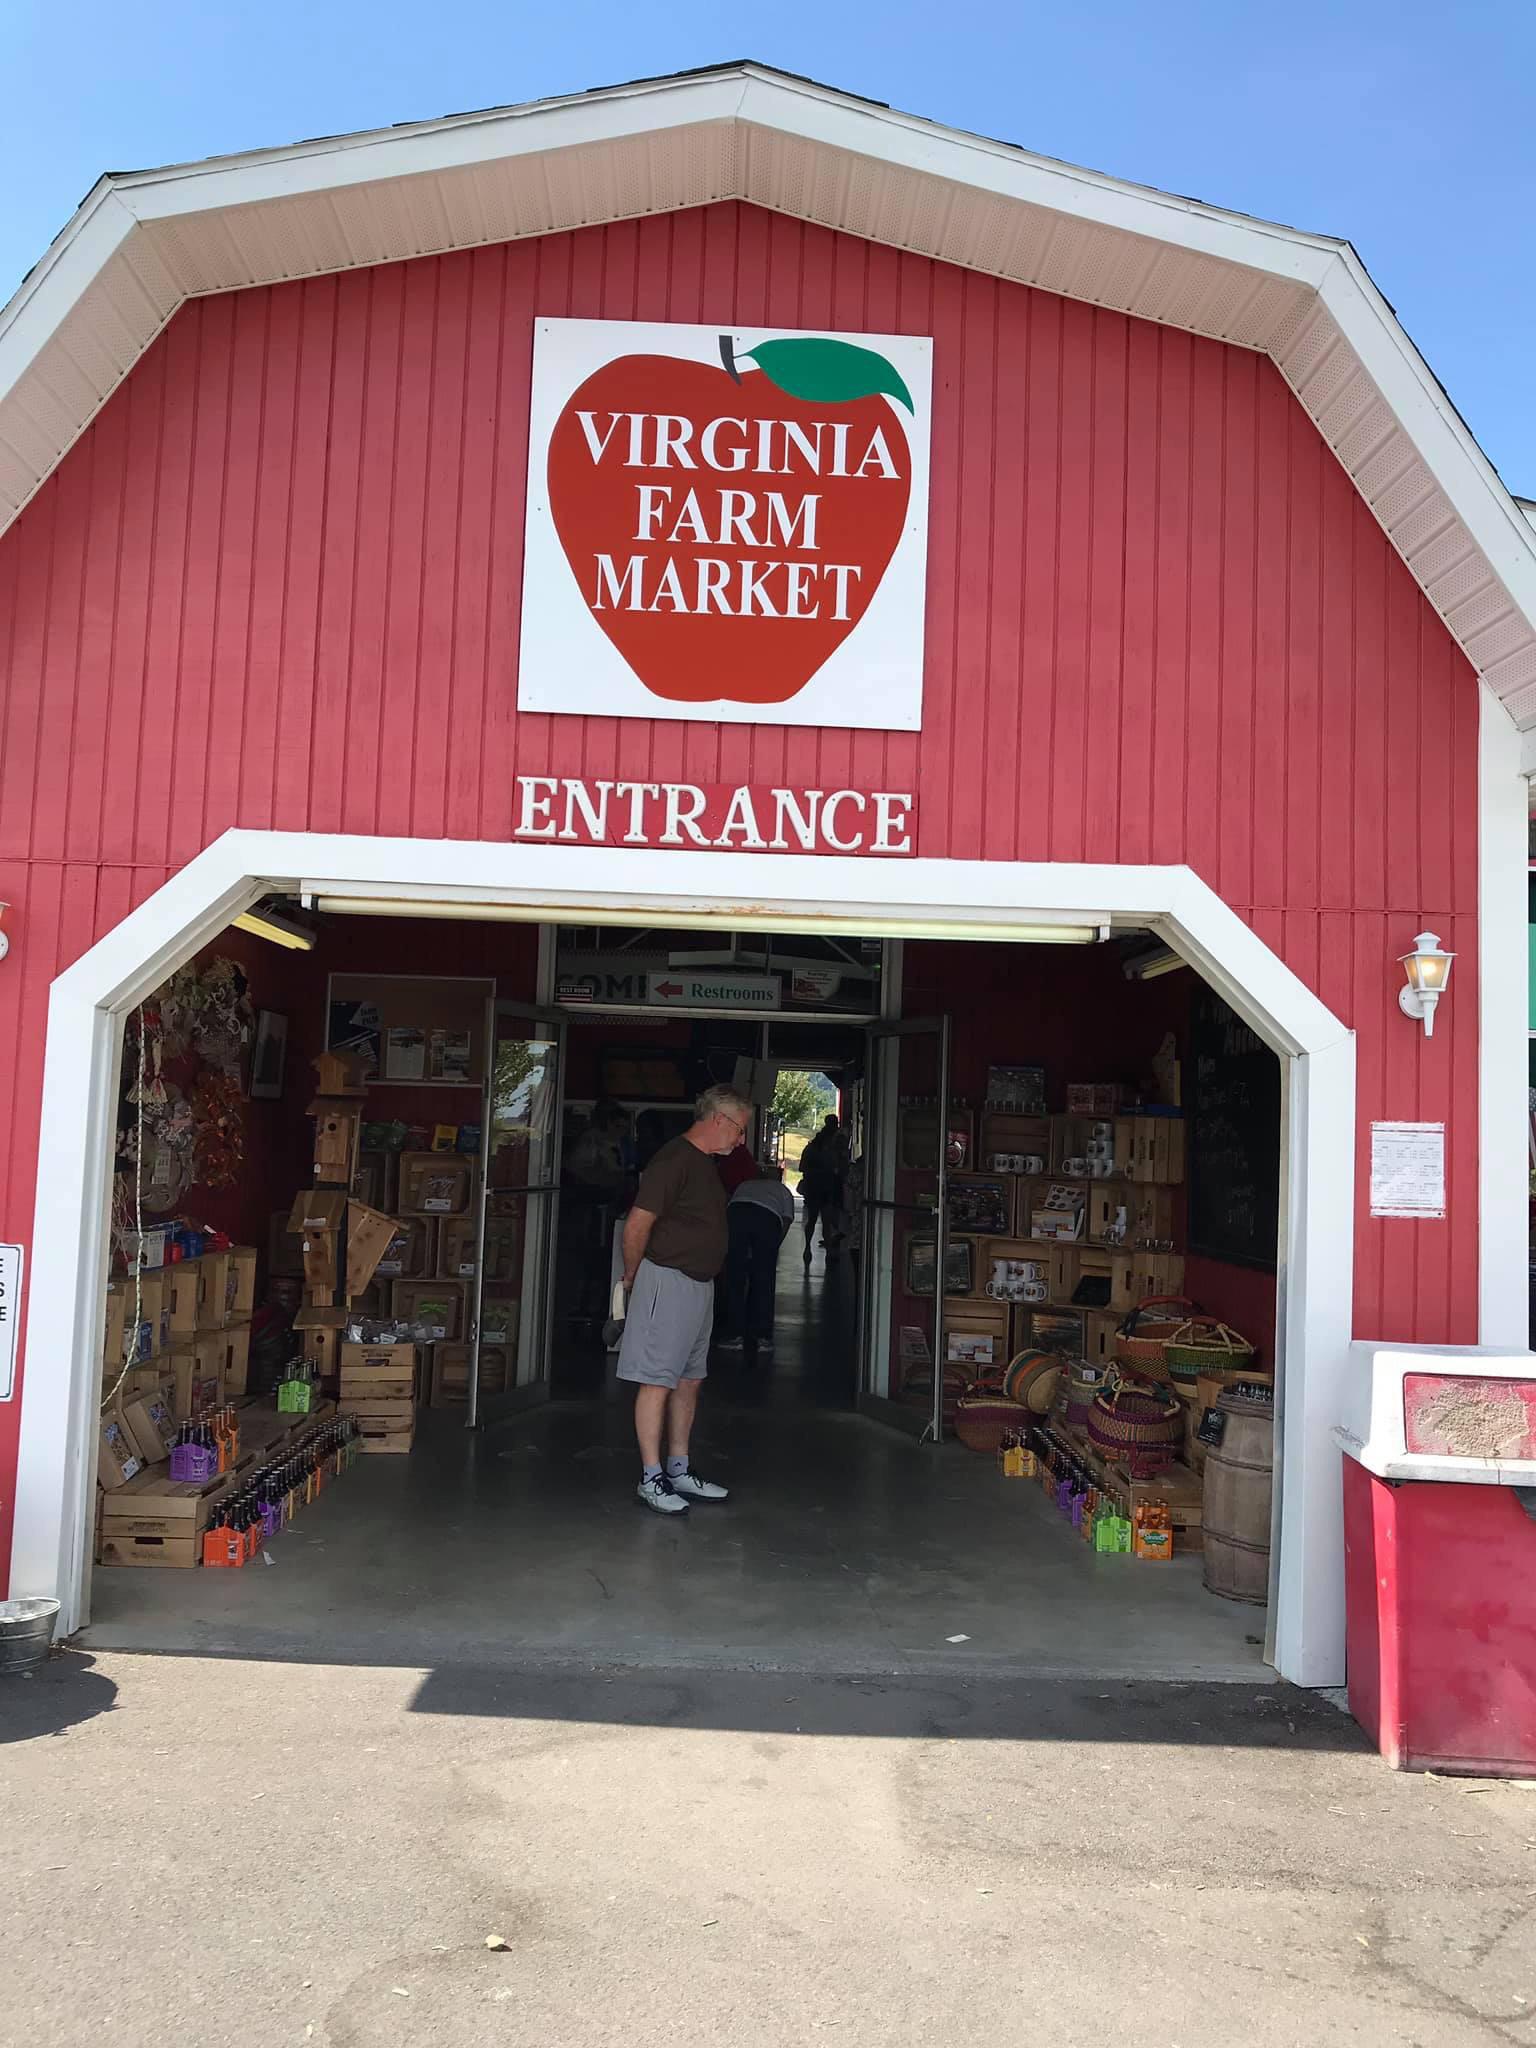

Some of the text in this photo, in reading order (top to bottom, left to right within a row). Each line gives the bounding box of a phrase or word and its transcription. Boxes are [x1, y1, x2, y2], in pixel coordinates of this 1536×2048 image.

[574, 410, 902, 480] VIRGINIA
[632, 485, 823, 550] FARM
[591, 554, 862, 621] MARKET
[514, 775, 913, 853] ENTRANCE
[691, 983, 774, 1001] Restrooms
